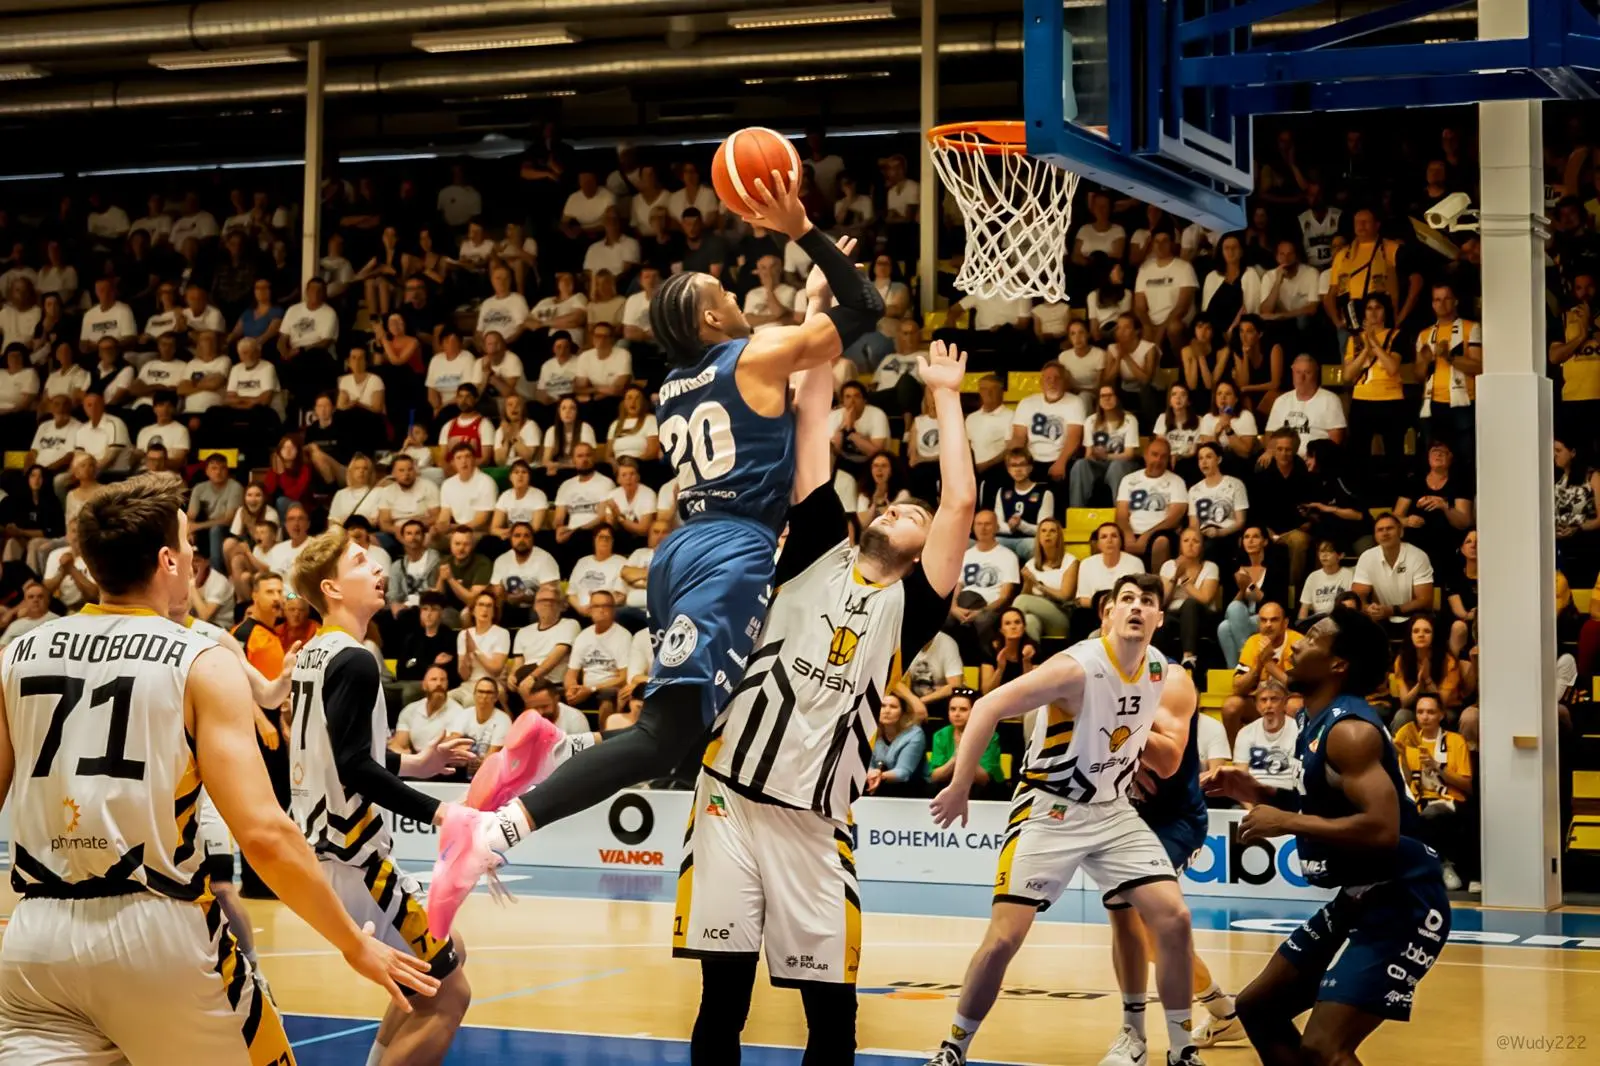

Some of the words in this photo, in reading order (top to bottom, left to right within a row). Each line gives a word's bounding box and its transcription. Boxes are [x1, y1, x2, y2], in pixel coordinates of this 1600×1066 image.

[659, 401, 736, 491] 20
[11, 635, 37, 665] M.
[1117, 695, 1142, 716] 13
[20, 675, 146, 781] 71
[869, 829, 960, 849] BOHEMIA
[598, 848, 664, 866] VIANOR
[800, 962, 829, 971] POLAR
